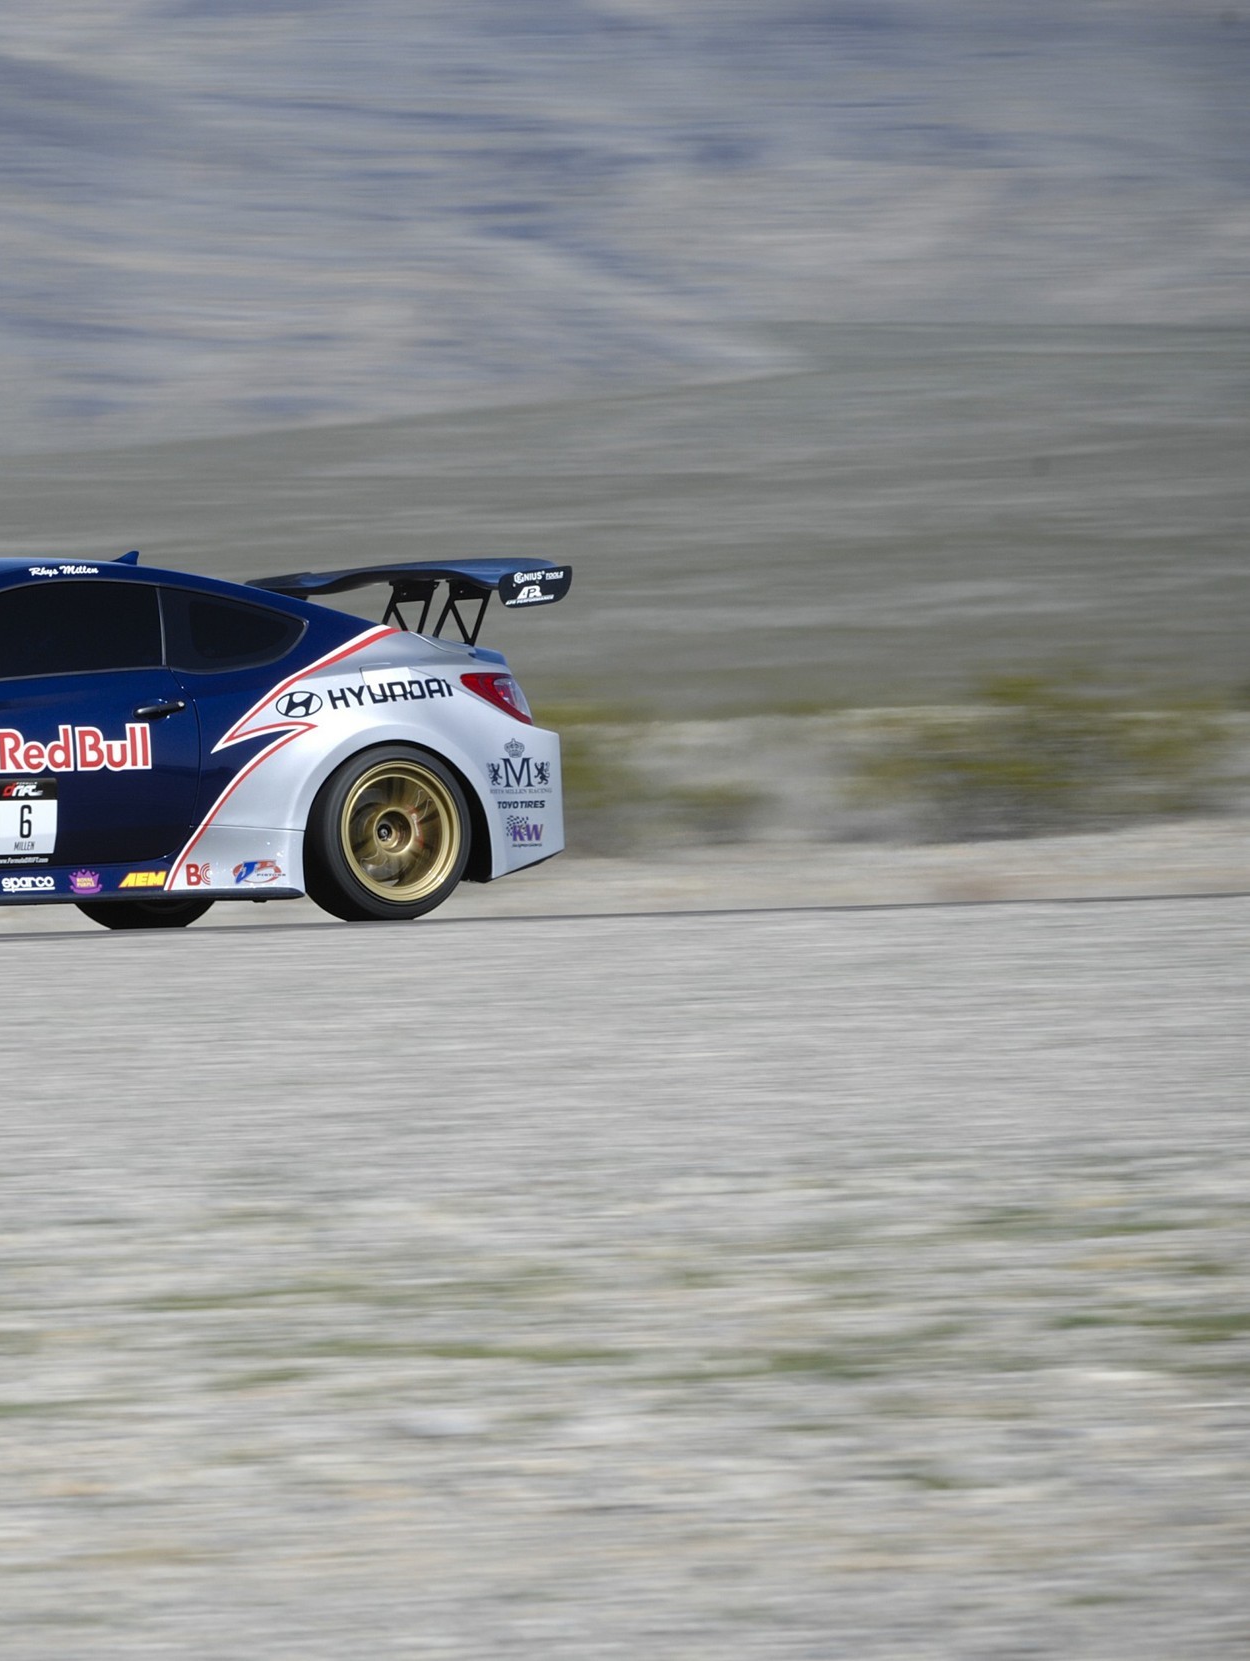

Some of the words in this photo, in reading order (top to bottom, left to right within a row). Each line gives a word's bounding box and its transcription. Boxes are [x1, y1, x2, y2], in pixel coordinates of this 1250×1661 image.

[29, 567, 59, 577] Rhys
[59, 565, 99, 575] Millen
[517, 585, 542, 600] APR
[327, 678, 454, 710] HYUNDAI
[500, 757, 534, 788] M
[19, 804, 33, 839] 6
[512, 823, 544, 842] KW
[13, 841, 35, 851] MILLEN
[1, 876, 55, 893] sparco
[118, 871, 167, 888] AEM
